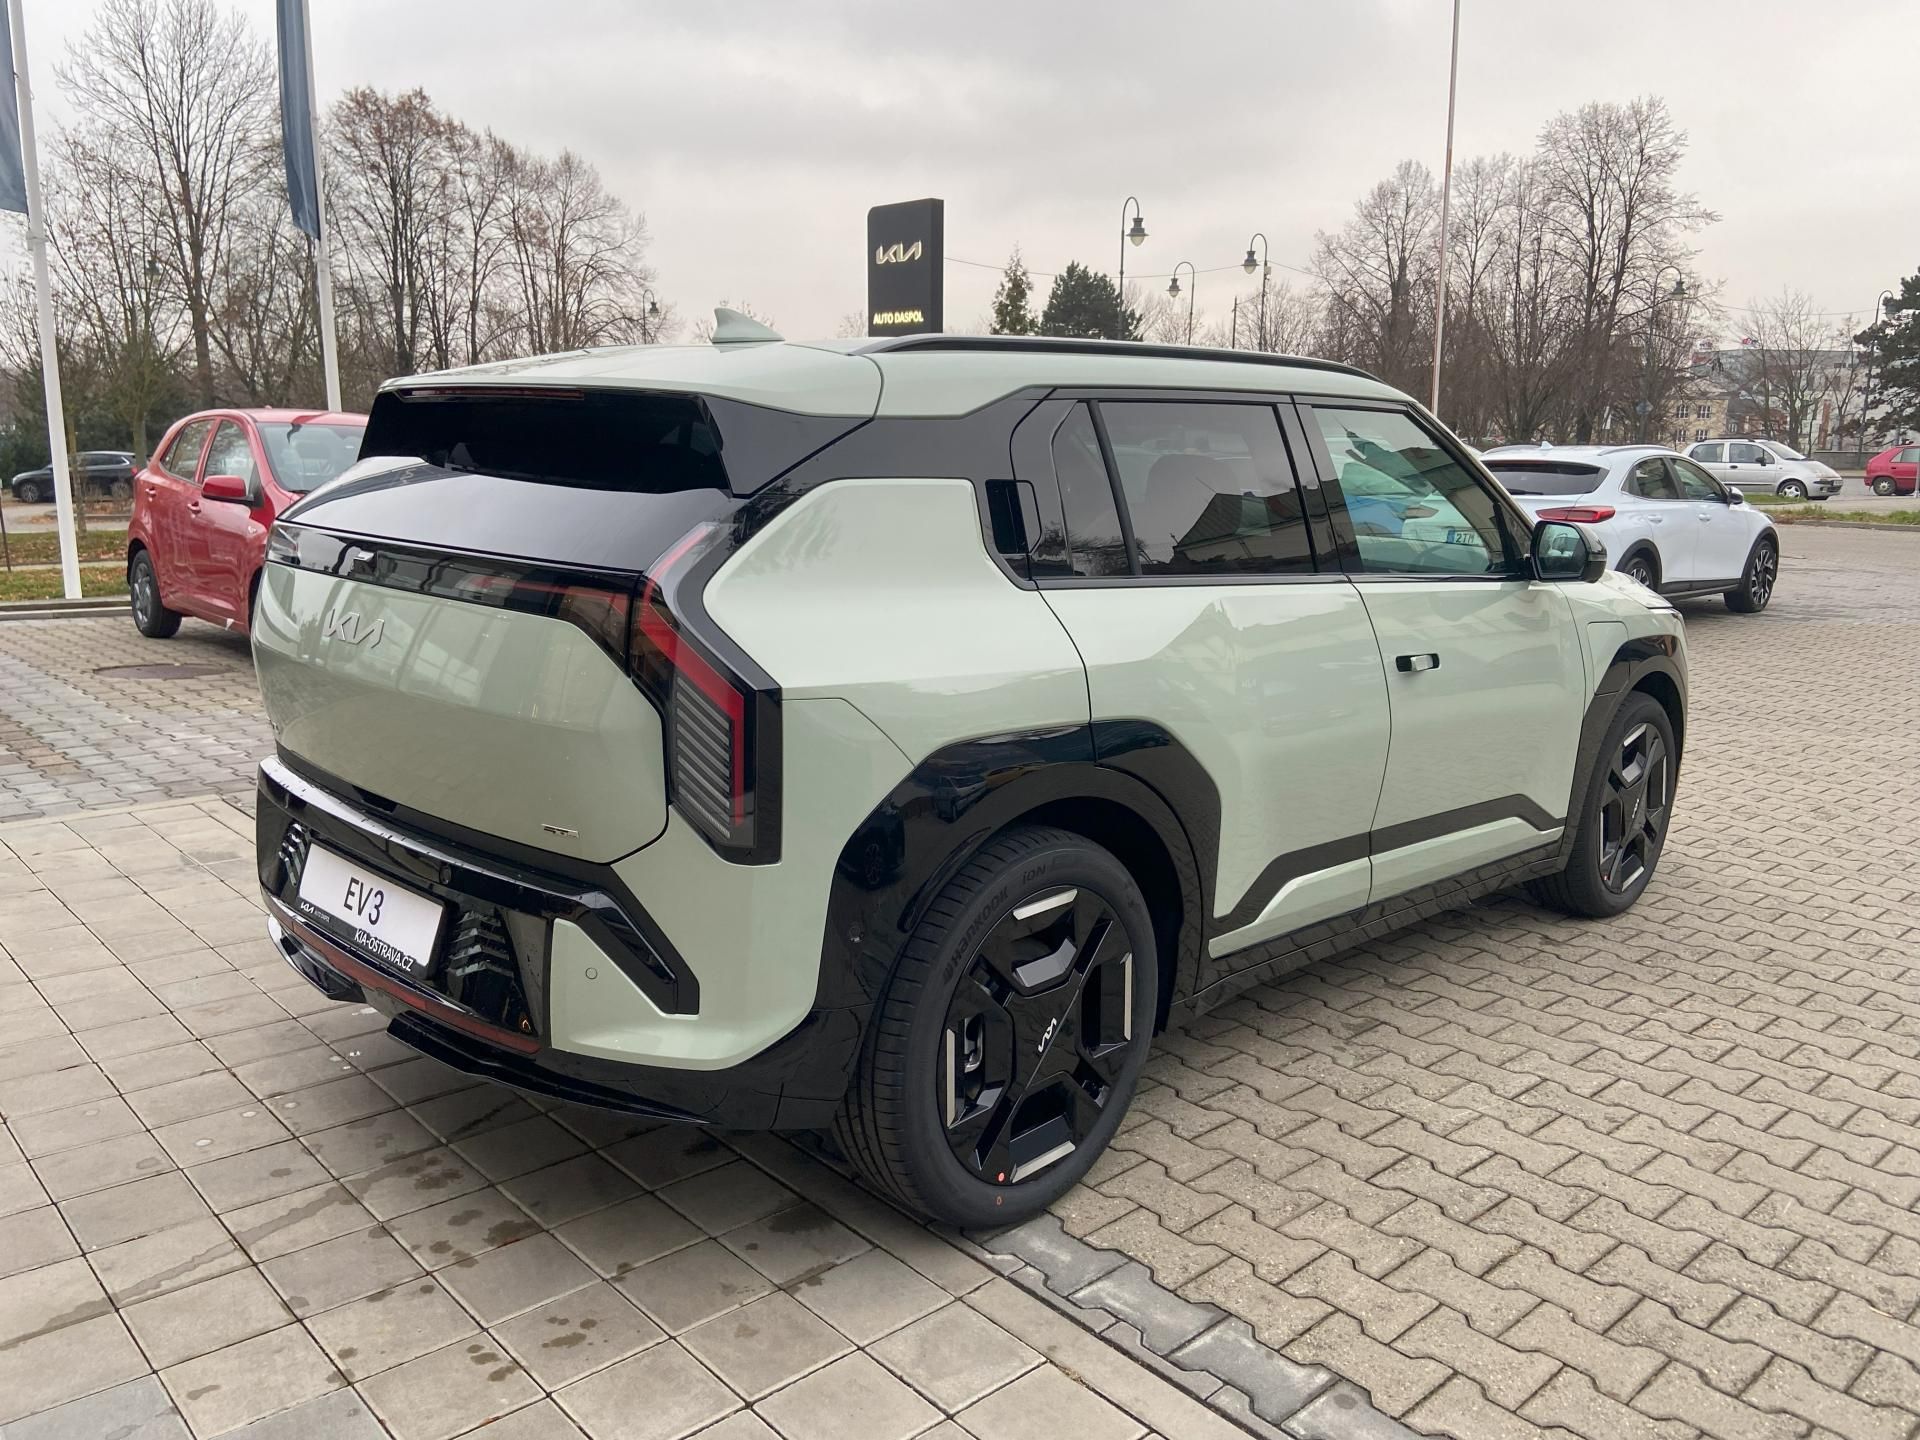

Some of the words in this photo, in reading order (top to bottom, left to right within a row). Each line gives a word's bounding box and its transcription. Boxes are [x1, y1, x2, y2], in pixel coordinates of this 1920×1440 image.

[875, 239, 922, 265] KIA
[873, 312, 894, 325] AUTO
[895, 310, 924, 324] DASPOL
[322, 608, 385, 649] KIA
[301, 901, 314, 914] KIA
[343, 877, 385, 926] EV3
[354, 928, 414, 972] KIA-OSTRAVA.CZ
[1038, 1017, 1057, 1052] KIA
